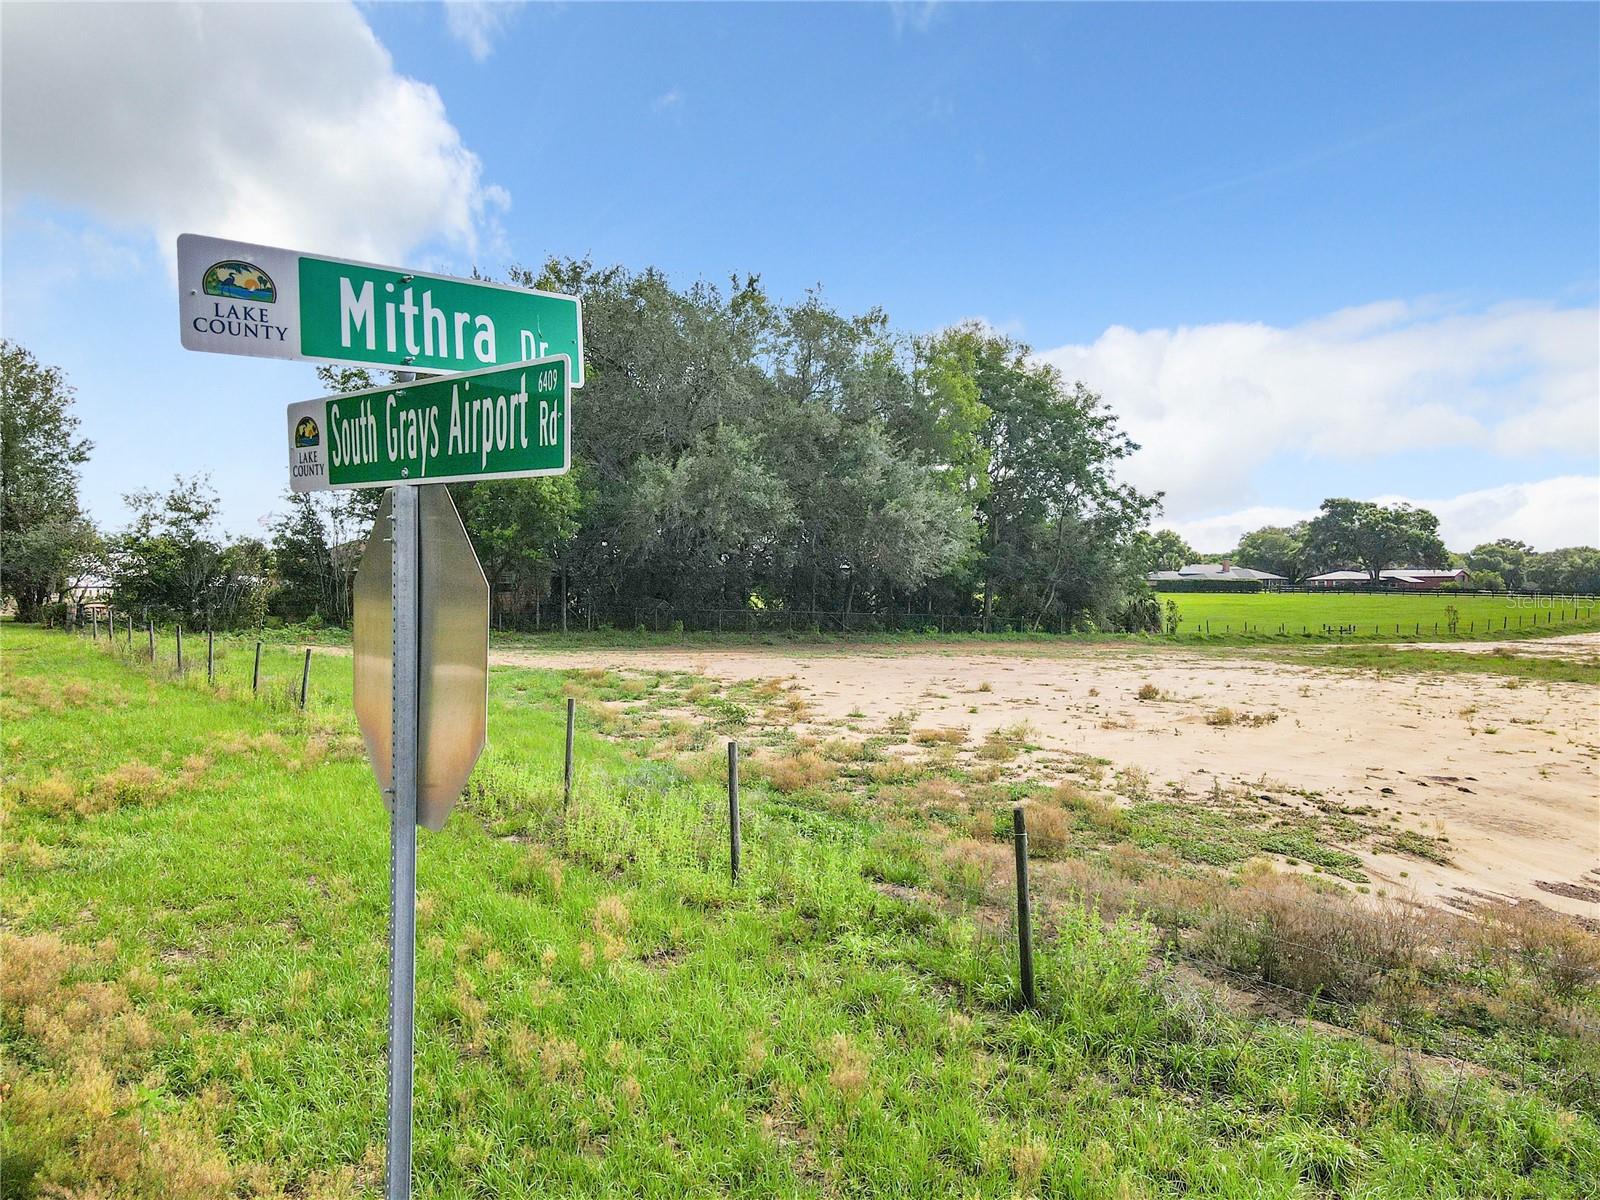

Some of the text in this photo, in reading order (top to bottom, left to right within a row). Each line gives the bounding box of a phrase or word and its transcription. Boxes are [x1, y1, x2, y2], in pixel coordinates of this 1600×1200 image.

[214, 302, 269, 323] LAKE
[339, 276, 549, 363] Mithra Dr
[193, 317, 288, 342] COUNTY
[537, 368, 558, 393] 6409
[330, 372, 558, 477] South Grays Airport Rd
[292, 463, 325, 477] COUNTY
[299, 451, 318, 464] LAKE
